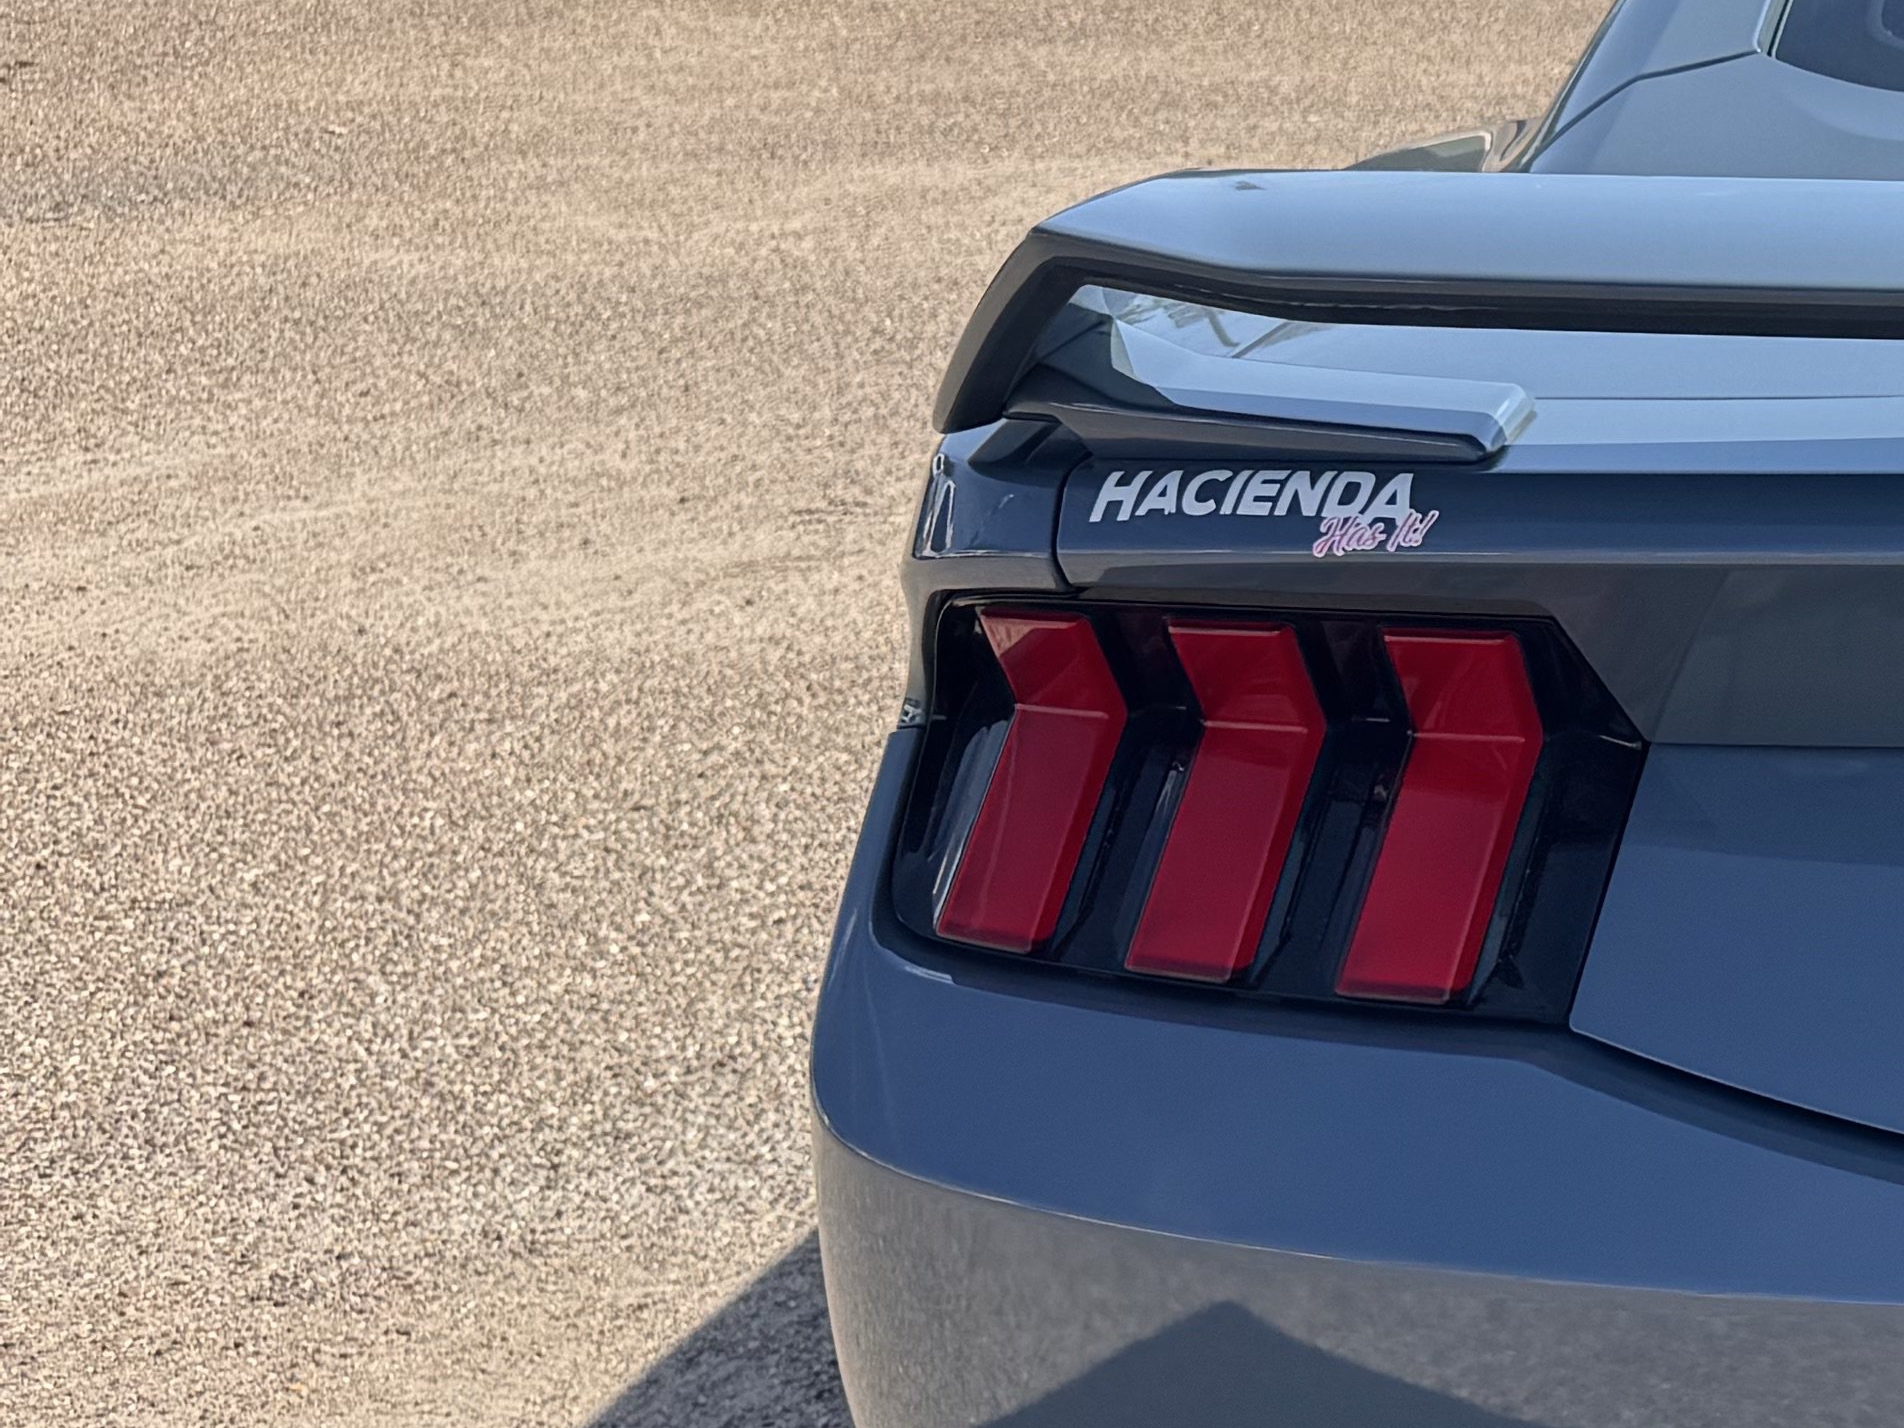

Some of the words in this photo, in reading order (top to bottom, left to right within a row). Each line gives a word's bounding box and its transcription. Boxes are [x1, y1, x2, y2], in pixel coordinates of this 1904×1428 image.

[1089, 469, 1413, 524] HACIENDA
[1313, 515, 1387, 557] Has
[1386, 508, 1440, 552] It!
